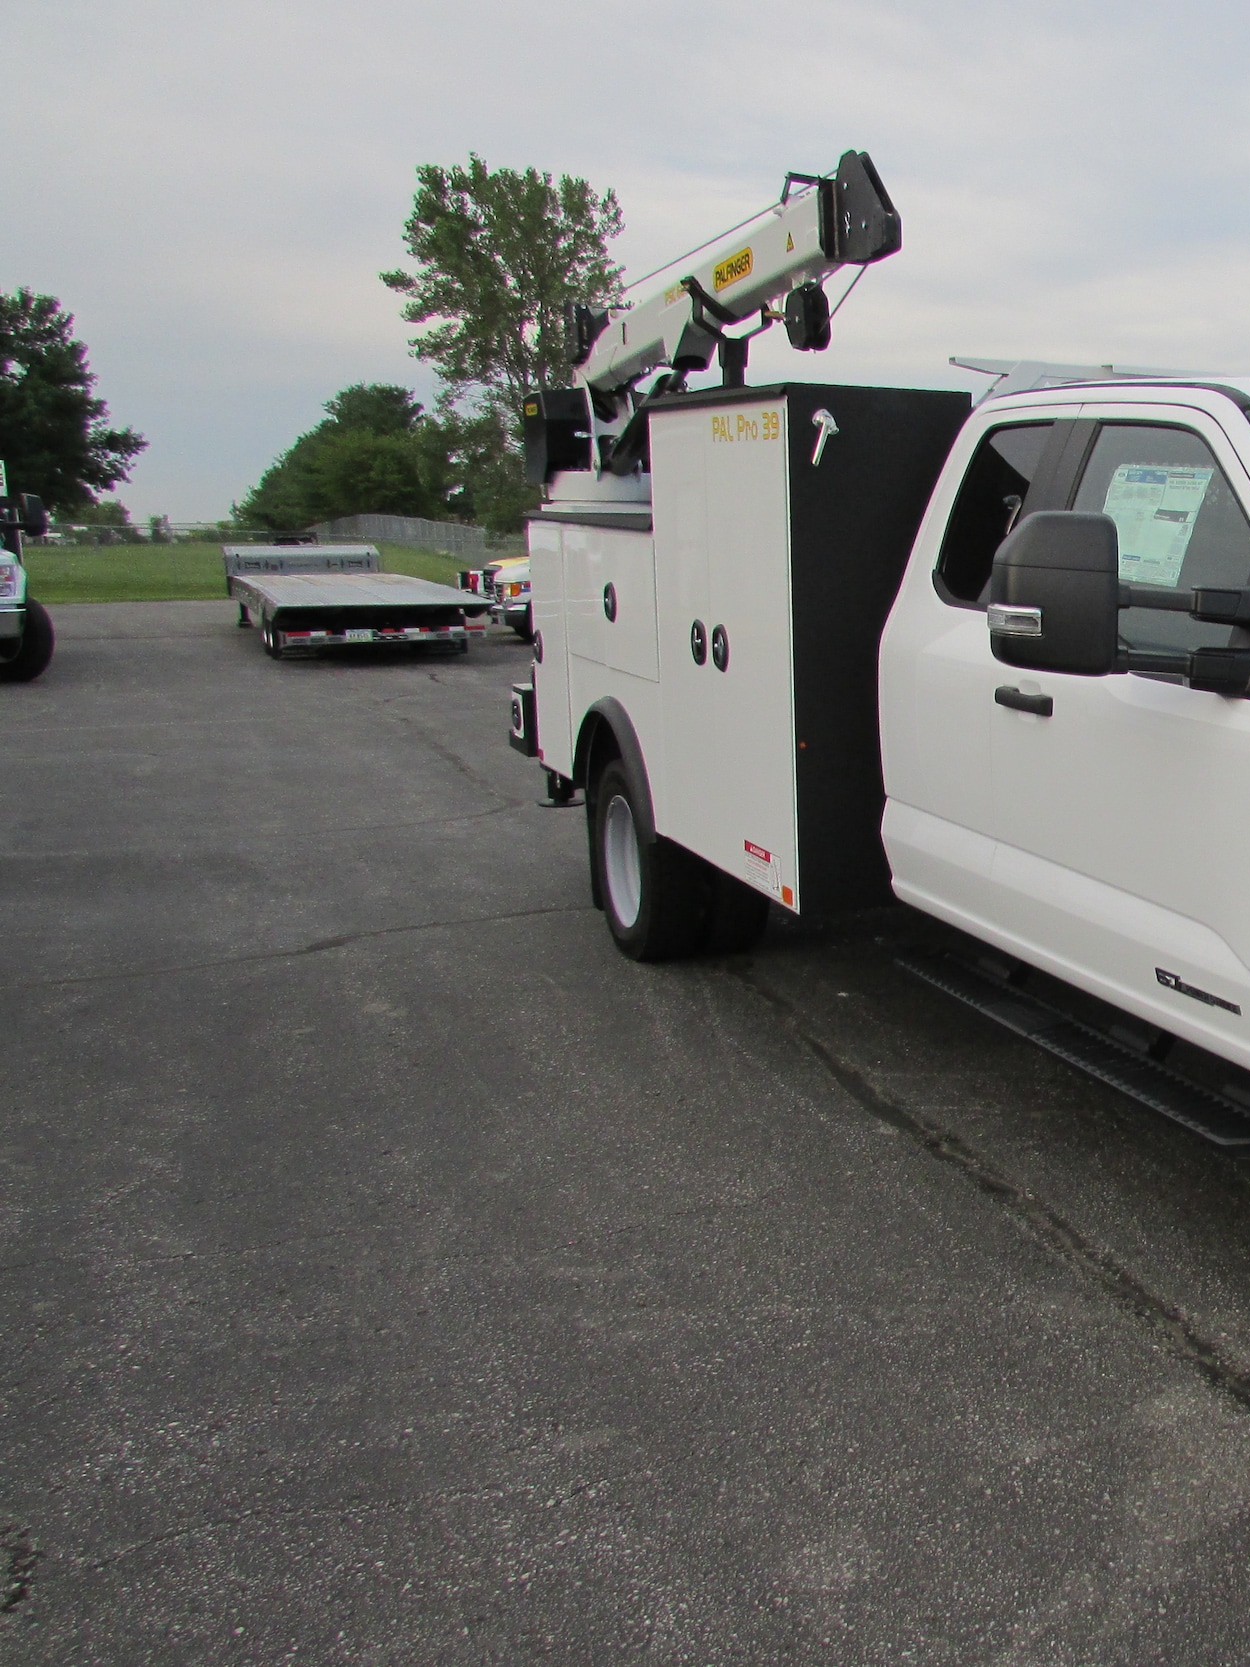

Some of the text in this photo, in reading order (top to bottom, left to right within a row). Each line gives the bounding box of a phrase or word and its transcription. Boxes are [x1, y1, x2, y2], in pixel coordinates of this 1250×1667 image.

[711, 412, 780, 443] PAL Pro 39
